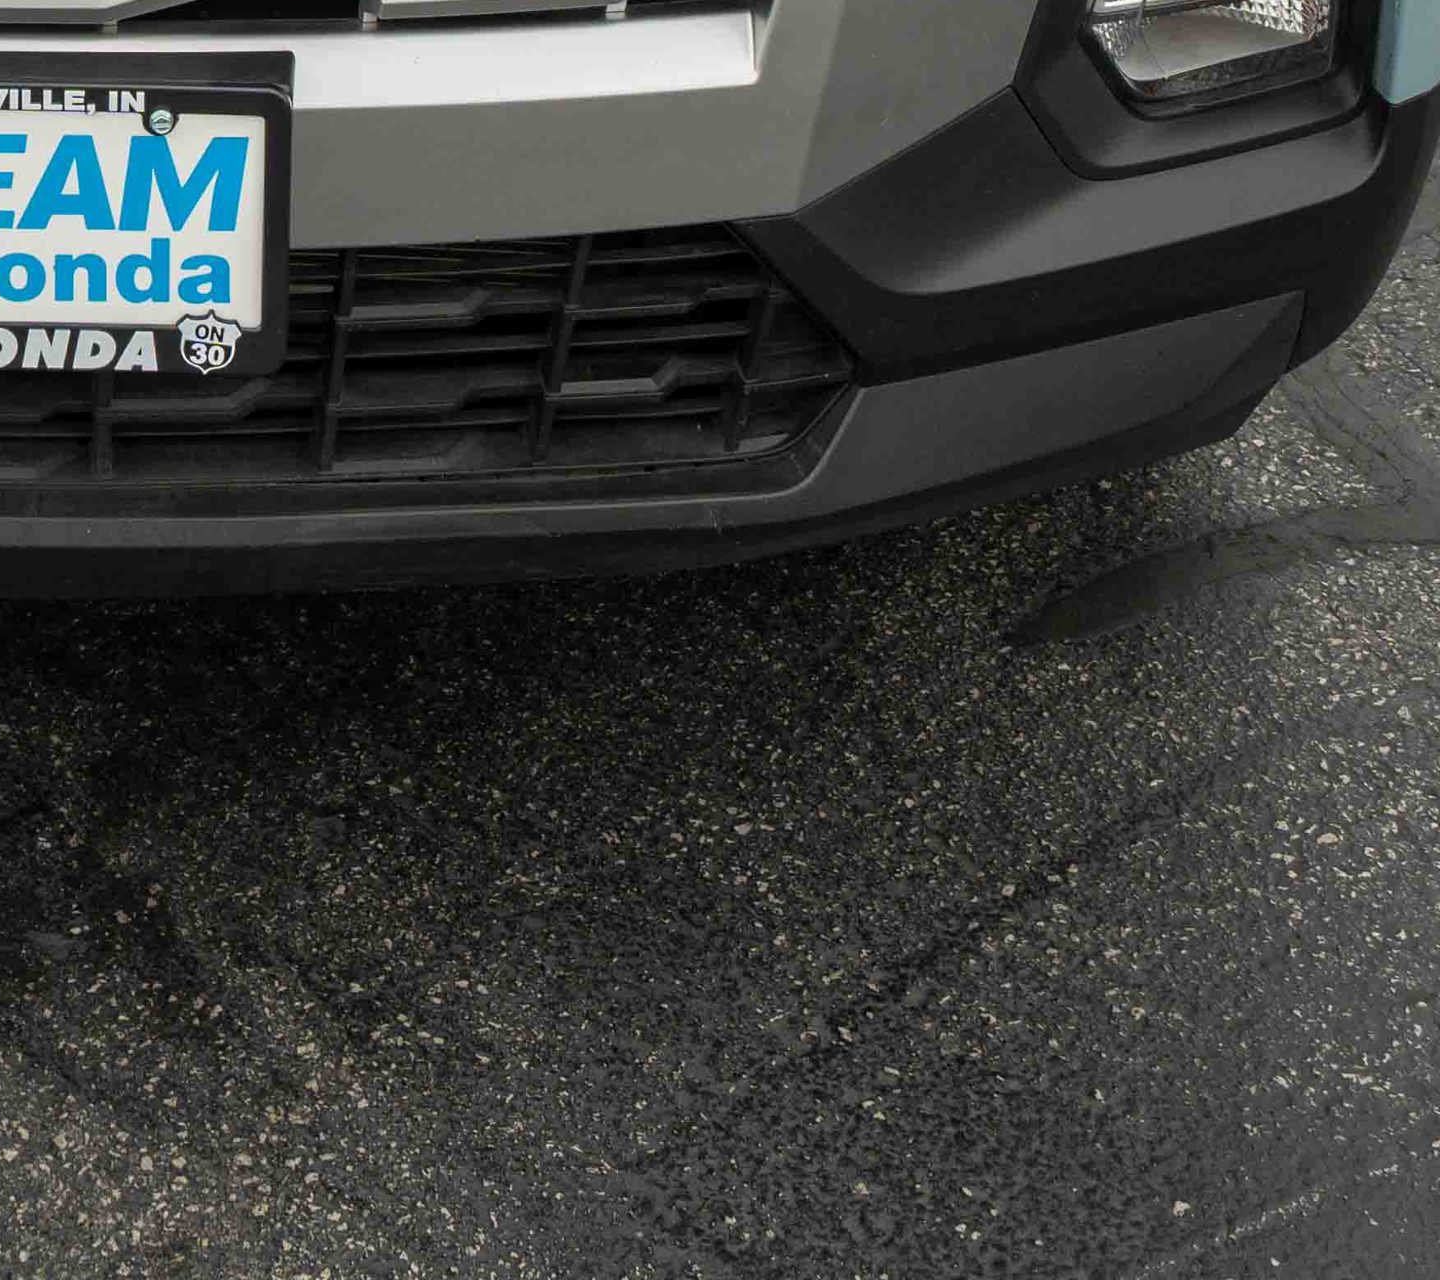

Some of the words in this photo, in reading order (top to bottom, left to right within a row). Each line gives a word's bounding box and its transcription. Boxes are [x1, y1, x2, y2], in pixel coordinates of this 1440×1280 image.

[108, 90, 146, 113] IN
[195, 324, 225, 343] ON
[189, 342, 225, 366] 30
